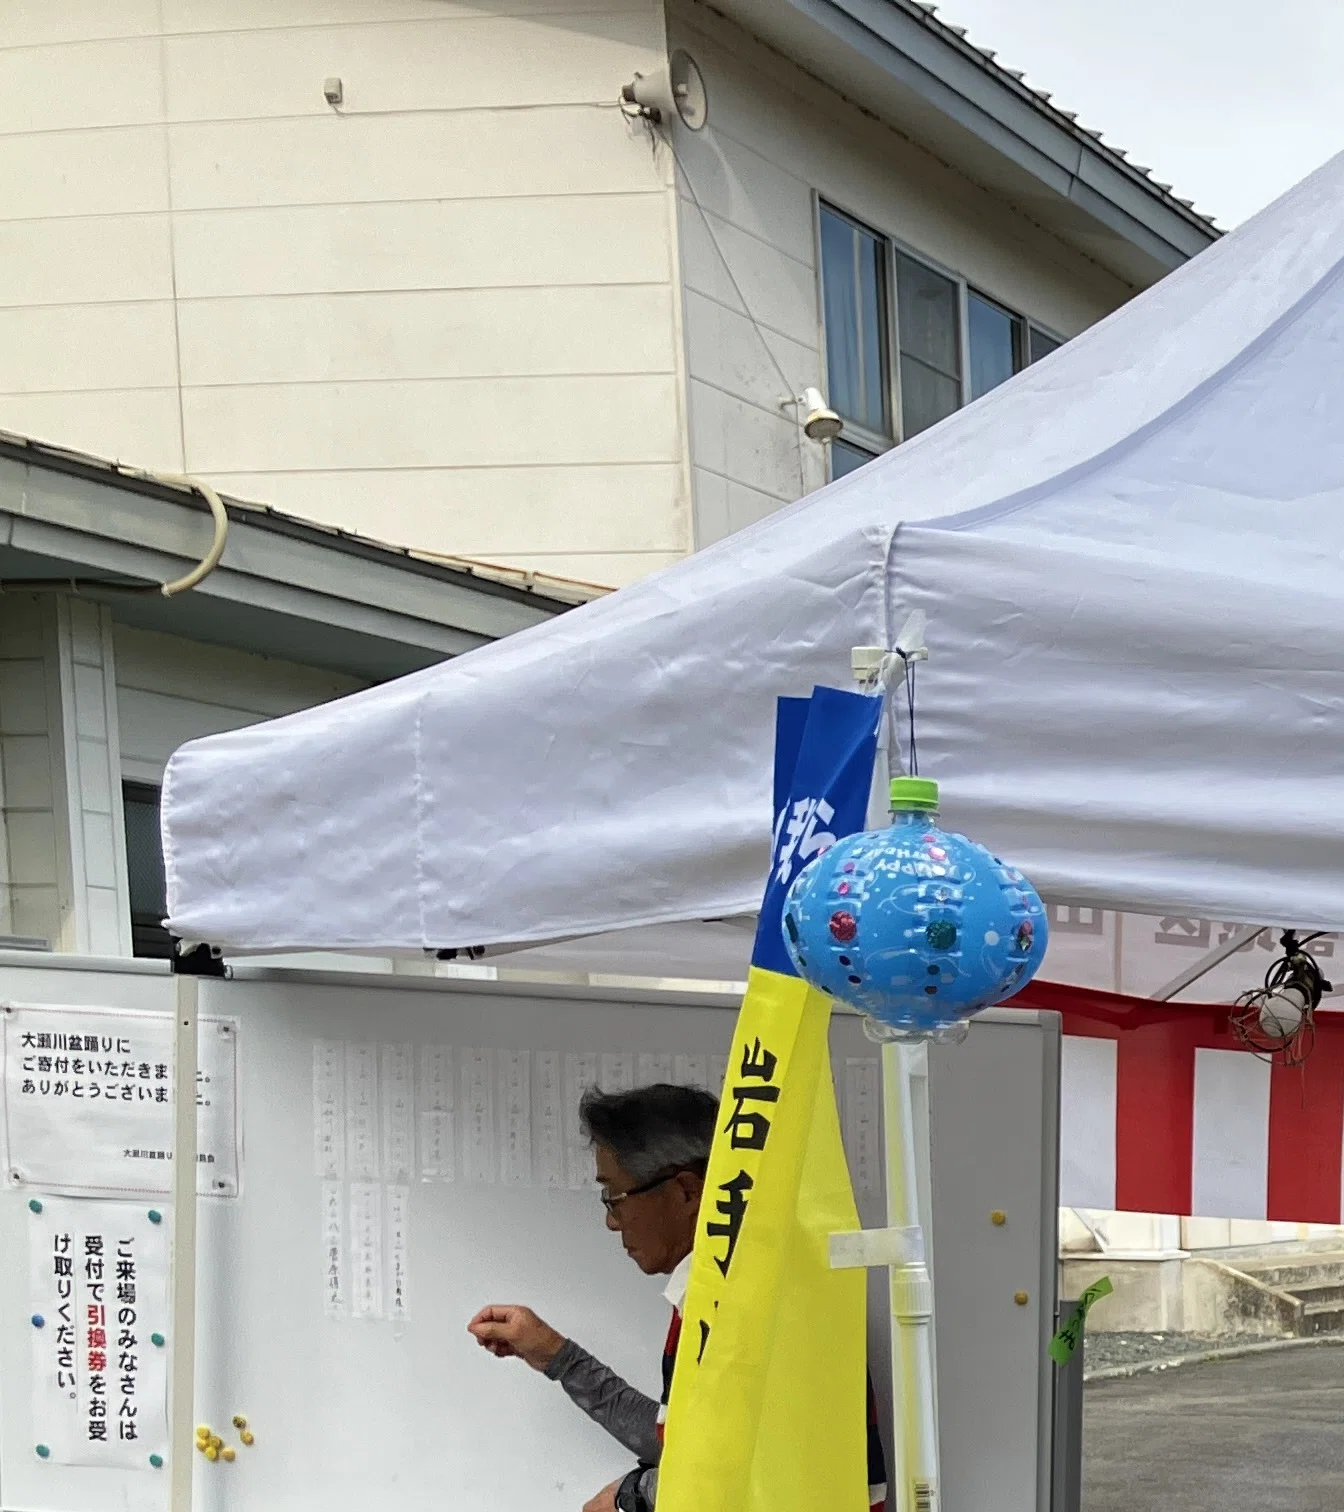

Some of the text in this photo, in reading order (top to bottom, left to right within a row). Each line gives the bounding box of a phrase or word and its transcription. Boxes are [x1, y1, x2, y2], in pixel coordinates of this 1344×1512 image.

[21, 1032, 132, 1054] 大瀬川盆踊りに
[53, 1232, 78, 1400] け取りください。
[84, 1234, 108, 1442] 受付で引換券をお受
[116, 1236, 138, 1441] ご来場のみなさんは
